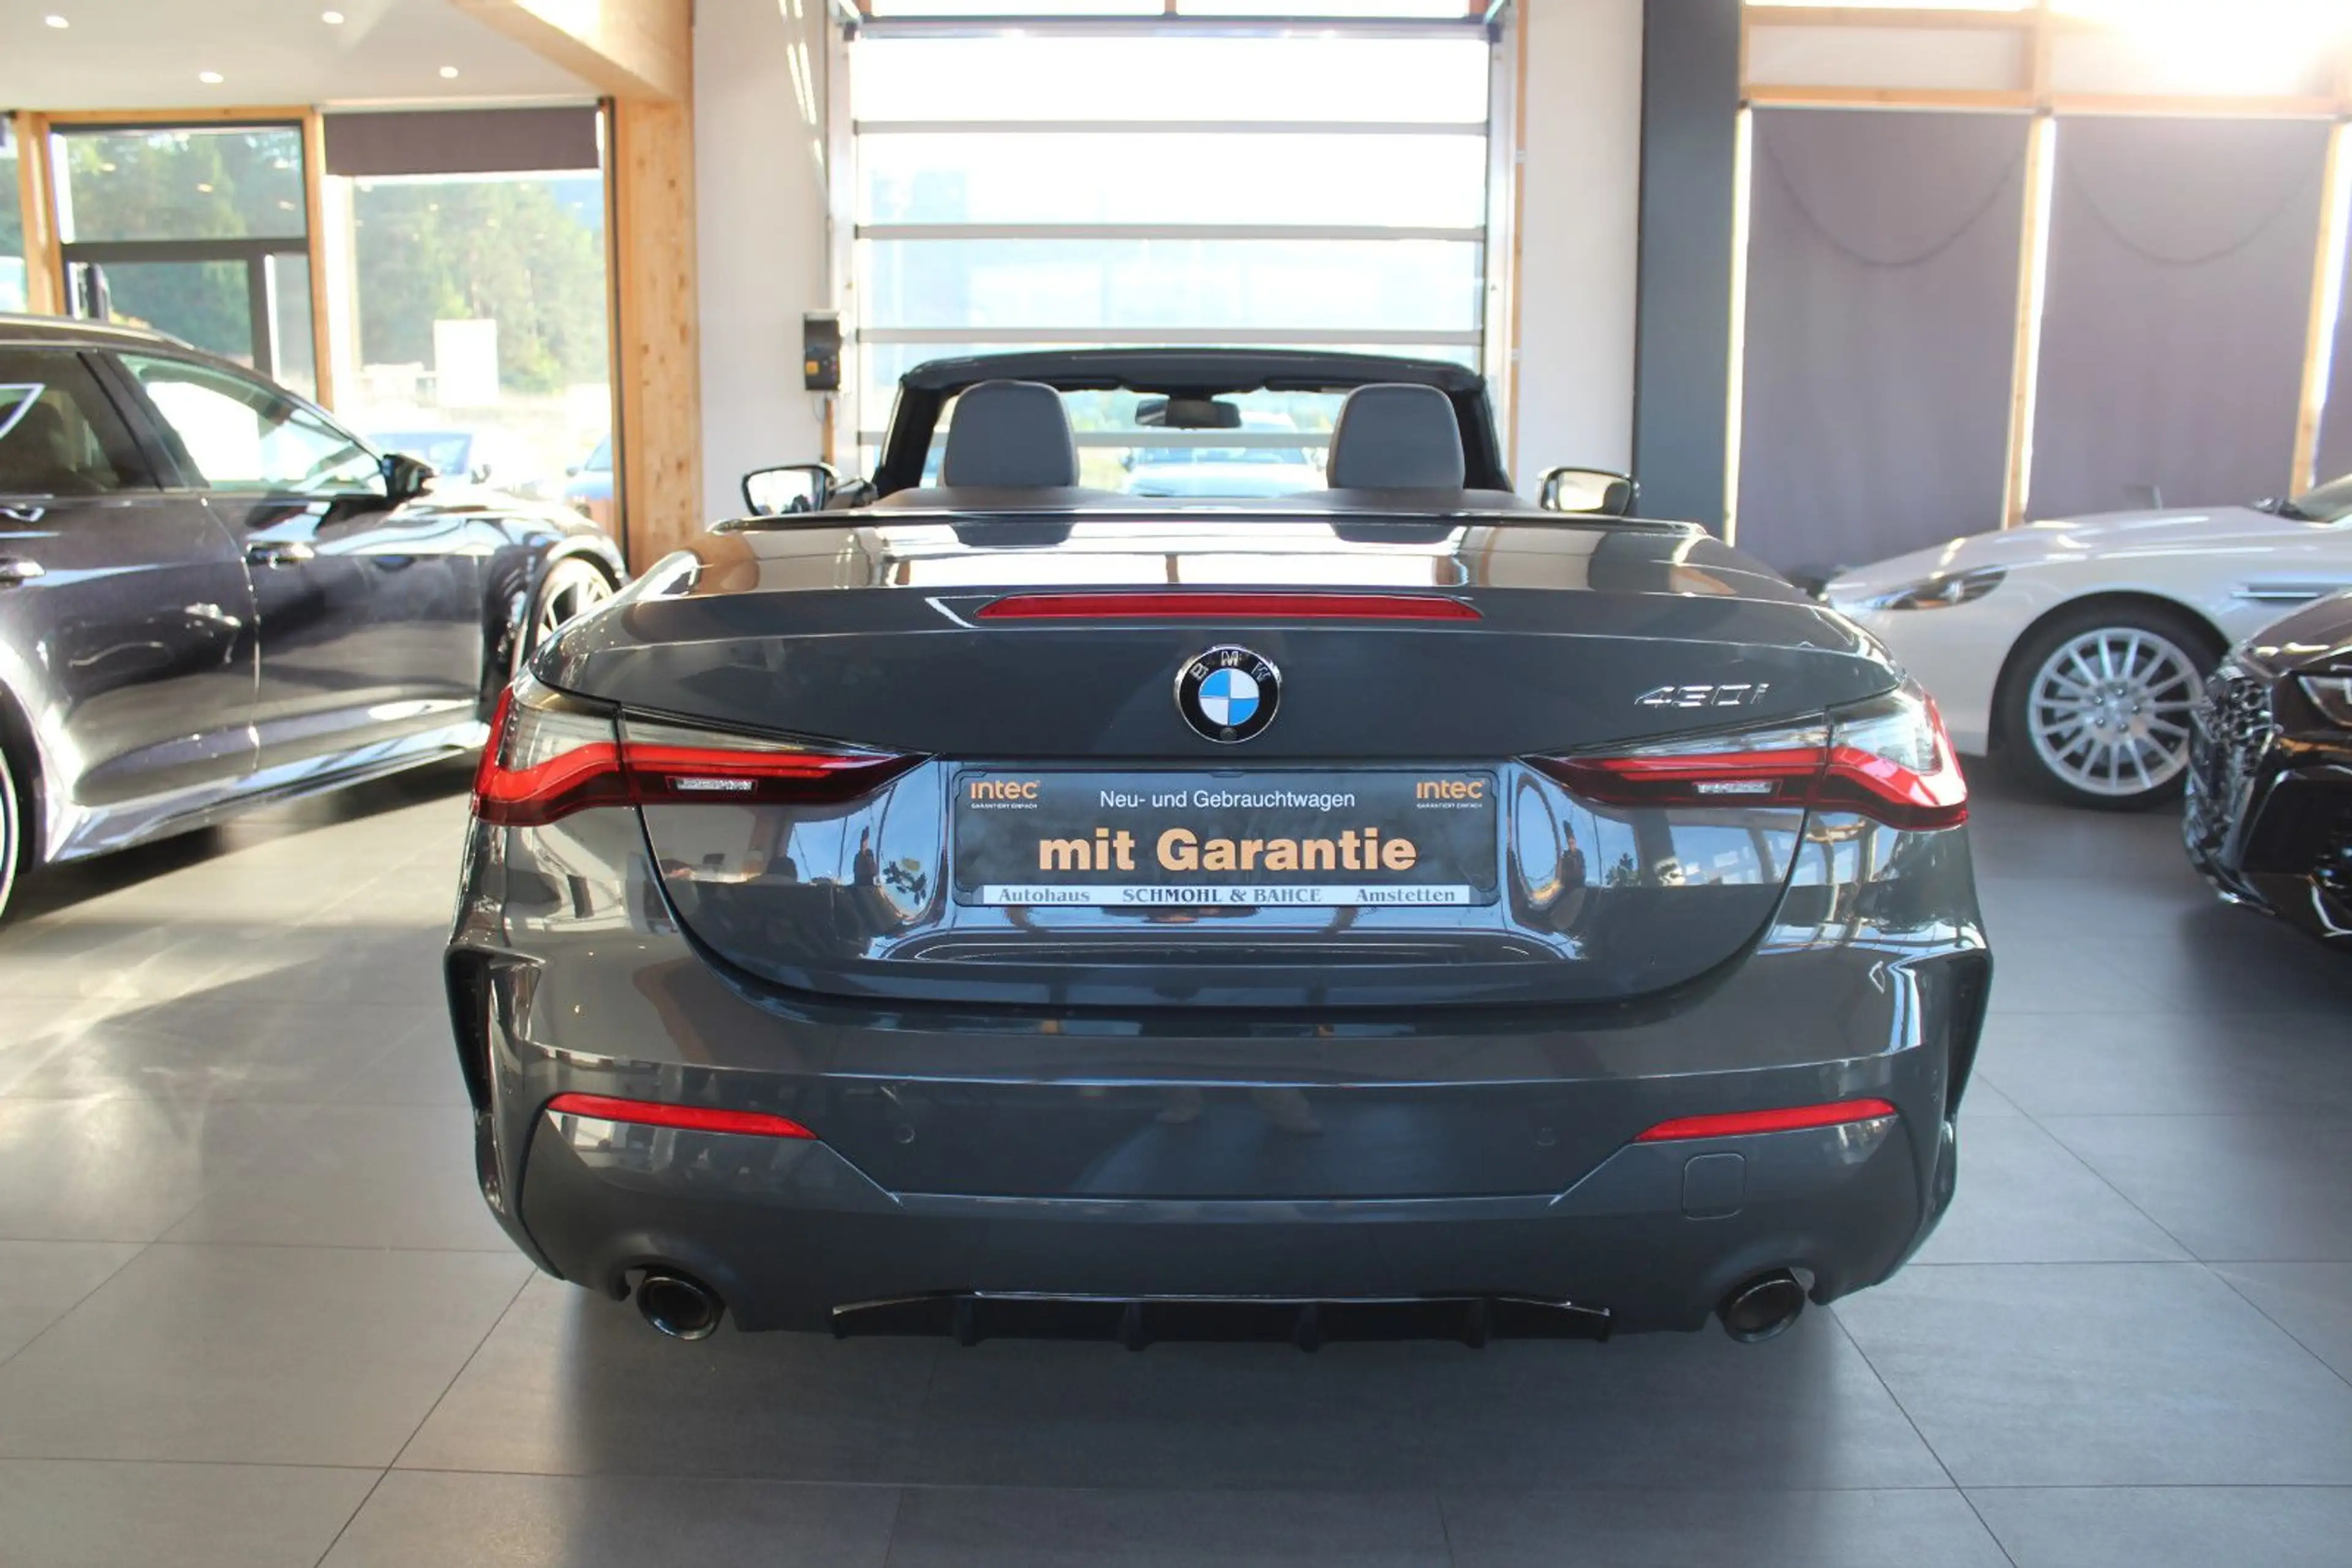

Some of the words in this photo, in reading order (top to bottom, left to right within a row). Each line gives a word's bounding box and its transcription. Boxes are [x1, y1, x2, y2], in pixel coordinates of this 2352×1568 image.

[1189, 650, 1271, 682] BMW
[971, 780, 1038, 799] intec
[1417, 780, 1483, 799] intec
[1100, 790, 1146, 808] Neu-
[1152, 790, 1187, 808] und
[1193, 790, 1355, 812] Gebrauchtwagen
[1039, 827, 1135, 870] mit
[1156, 827, 1417, 871] Garantie
[999, 888, 1090, 902] Autohaus
[1122, 888, 1222, 902] SCHMOHL
[1229, 888, 1246, 903] &
[1355, 888, 1456, 902] Amstetten
